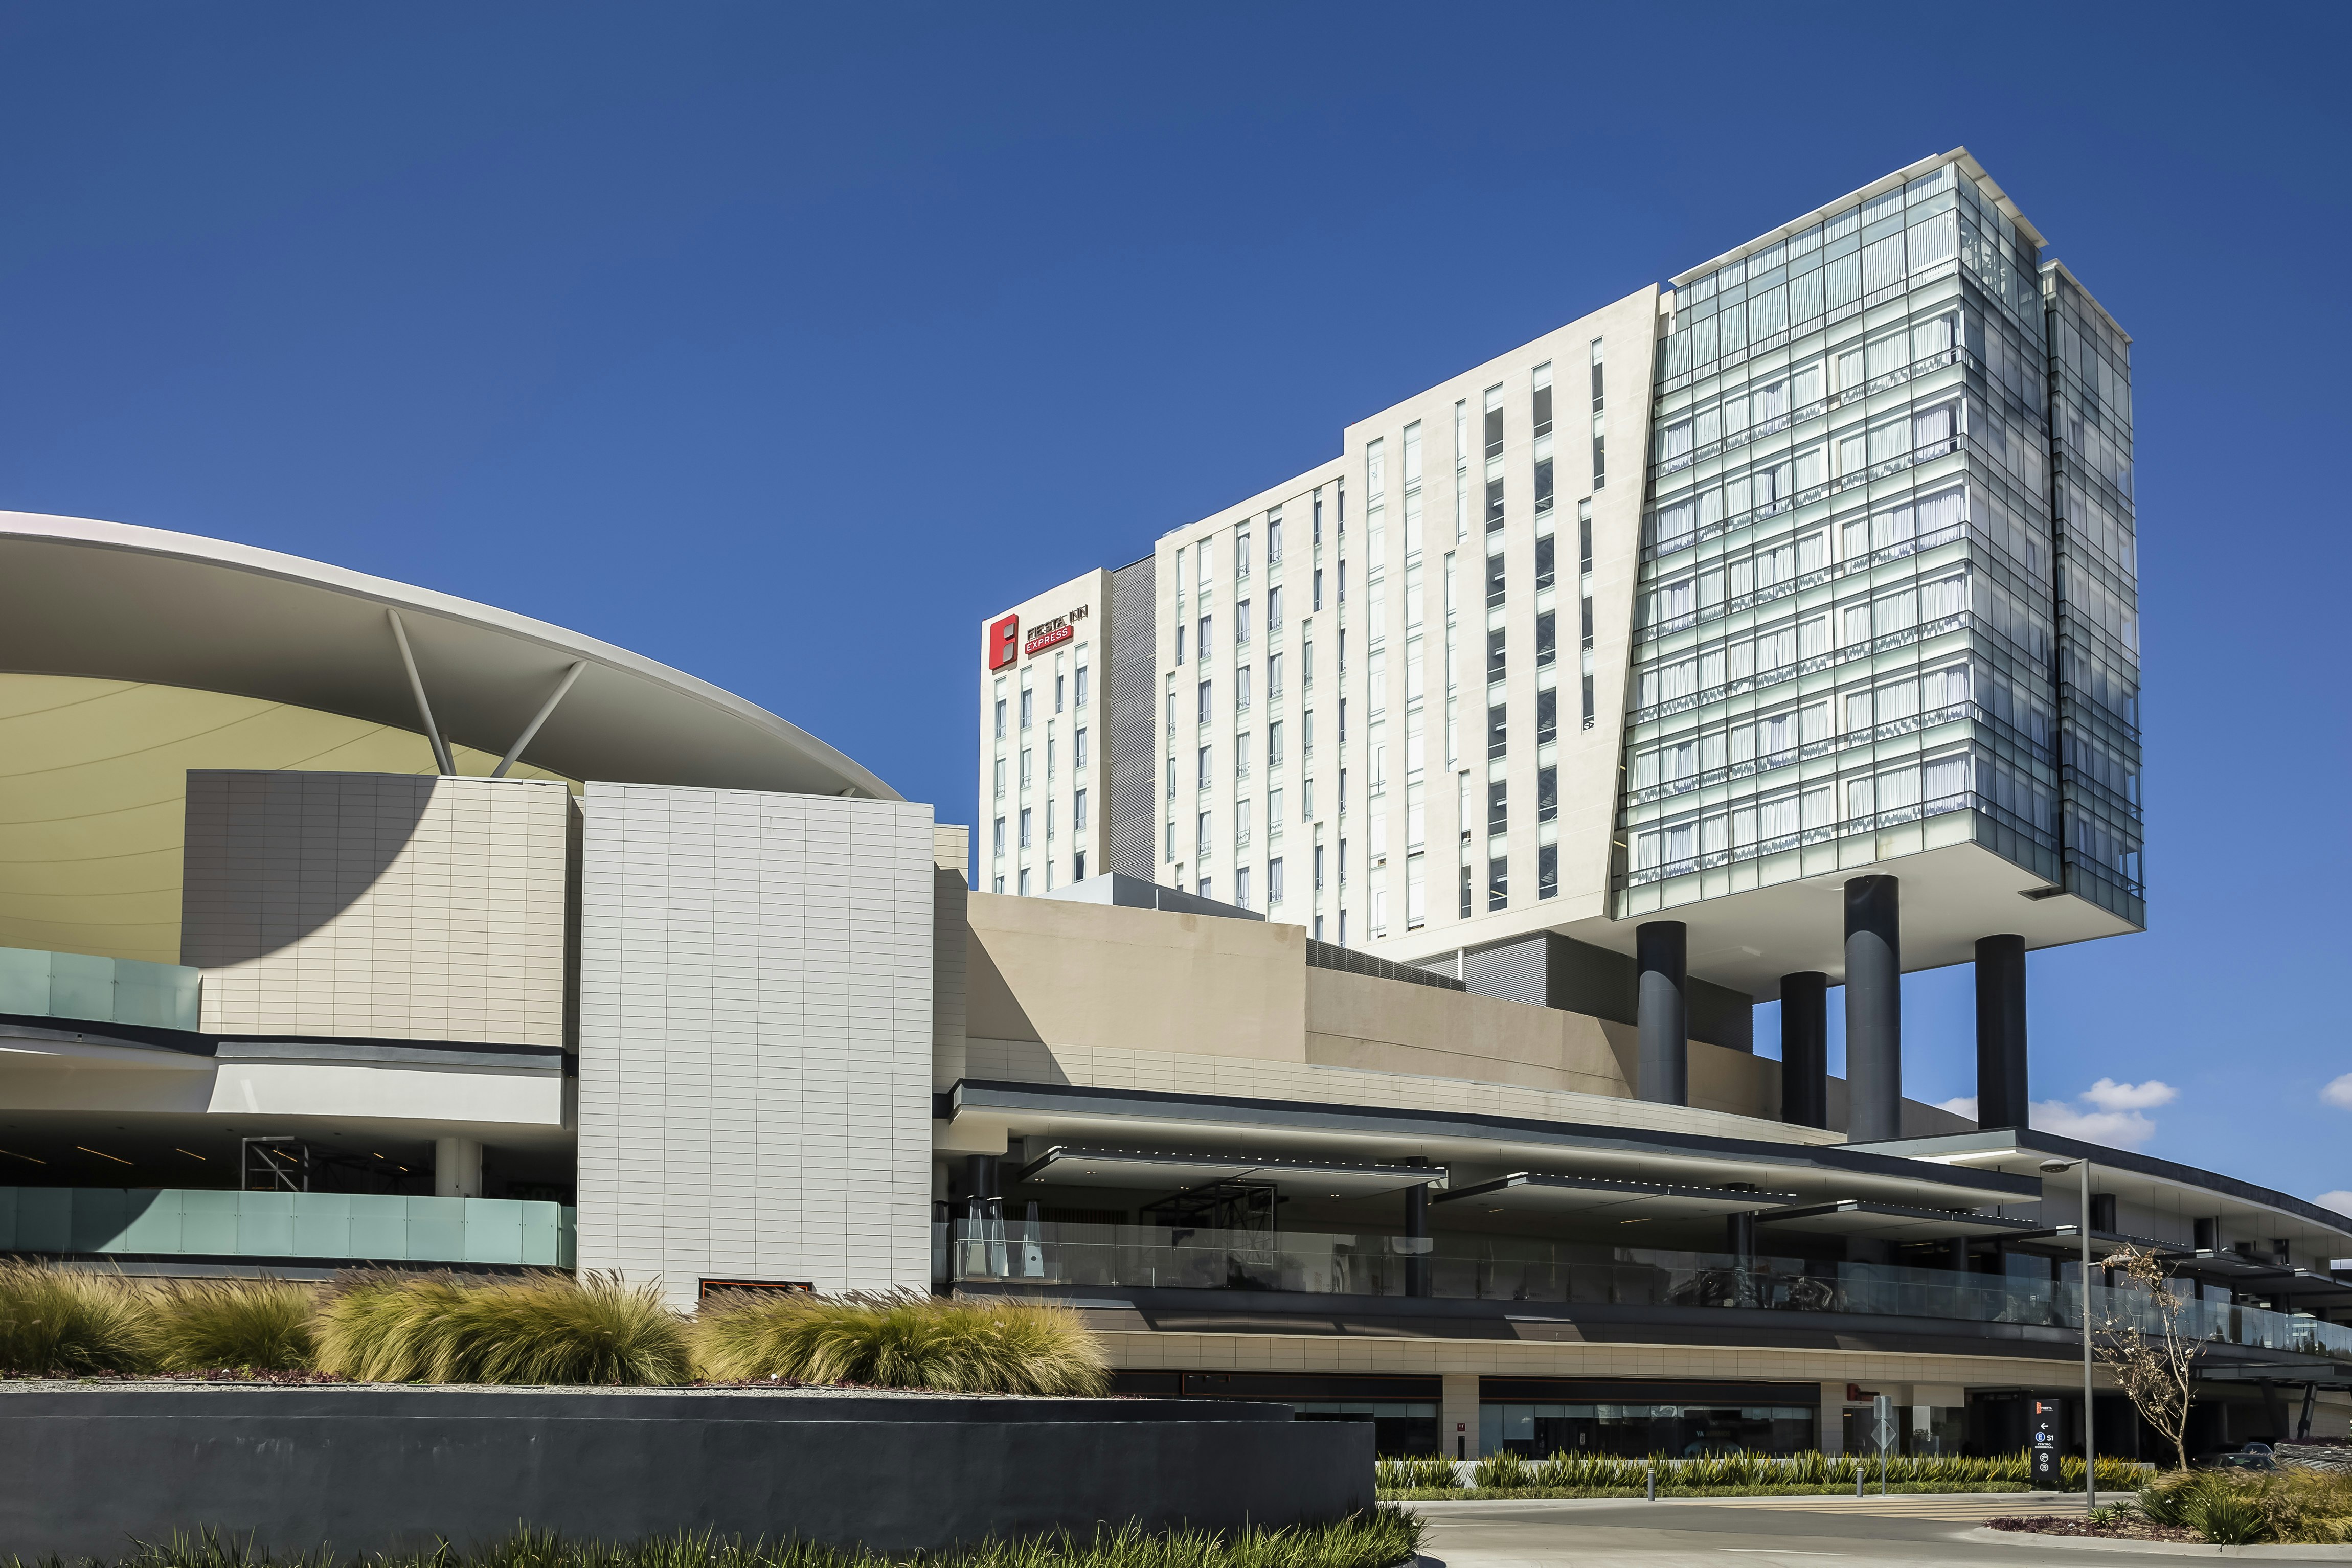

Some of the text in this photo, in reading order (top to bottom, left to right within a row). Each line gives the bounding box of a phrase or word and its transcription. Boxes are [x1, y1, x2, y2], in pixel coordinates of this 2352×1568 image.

[1027, 604, 1088, 640] FIESTA INN
[1027, 628, 1068, 651] EXPRESS
